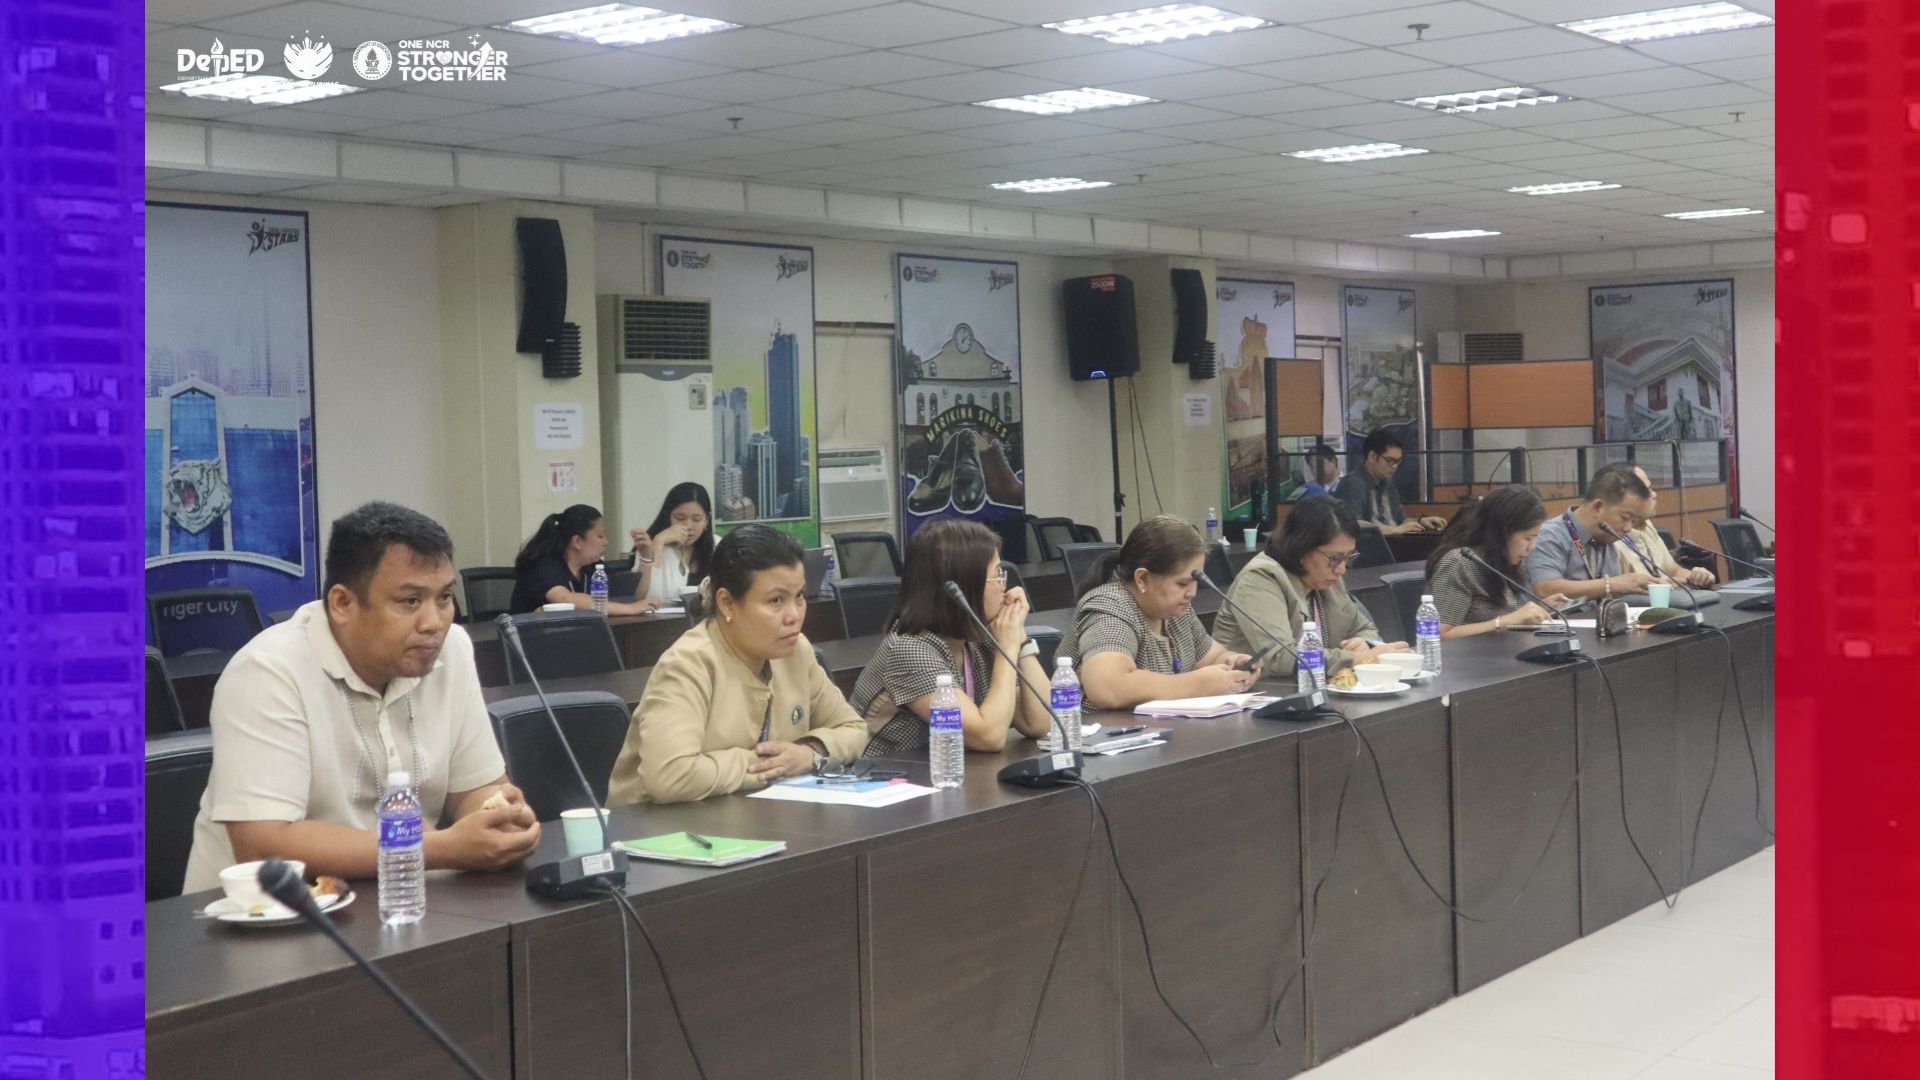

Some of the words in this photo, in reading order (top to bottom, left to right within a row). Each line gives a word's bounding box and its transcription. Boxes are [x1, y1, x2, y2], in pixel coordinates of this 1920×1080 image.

[266, 233, 299, 251] STARS
[926, 407, 973, 442] MARIKINA
[978, 409, 1008, 438] SHOES
[207, 600, 239, 616] City
[396, 826, 411, 838] My
